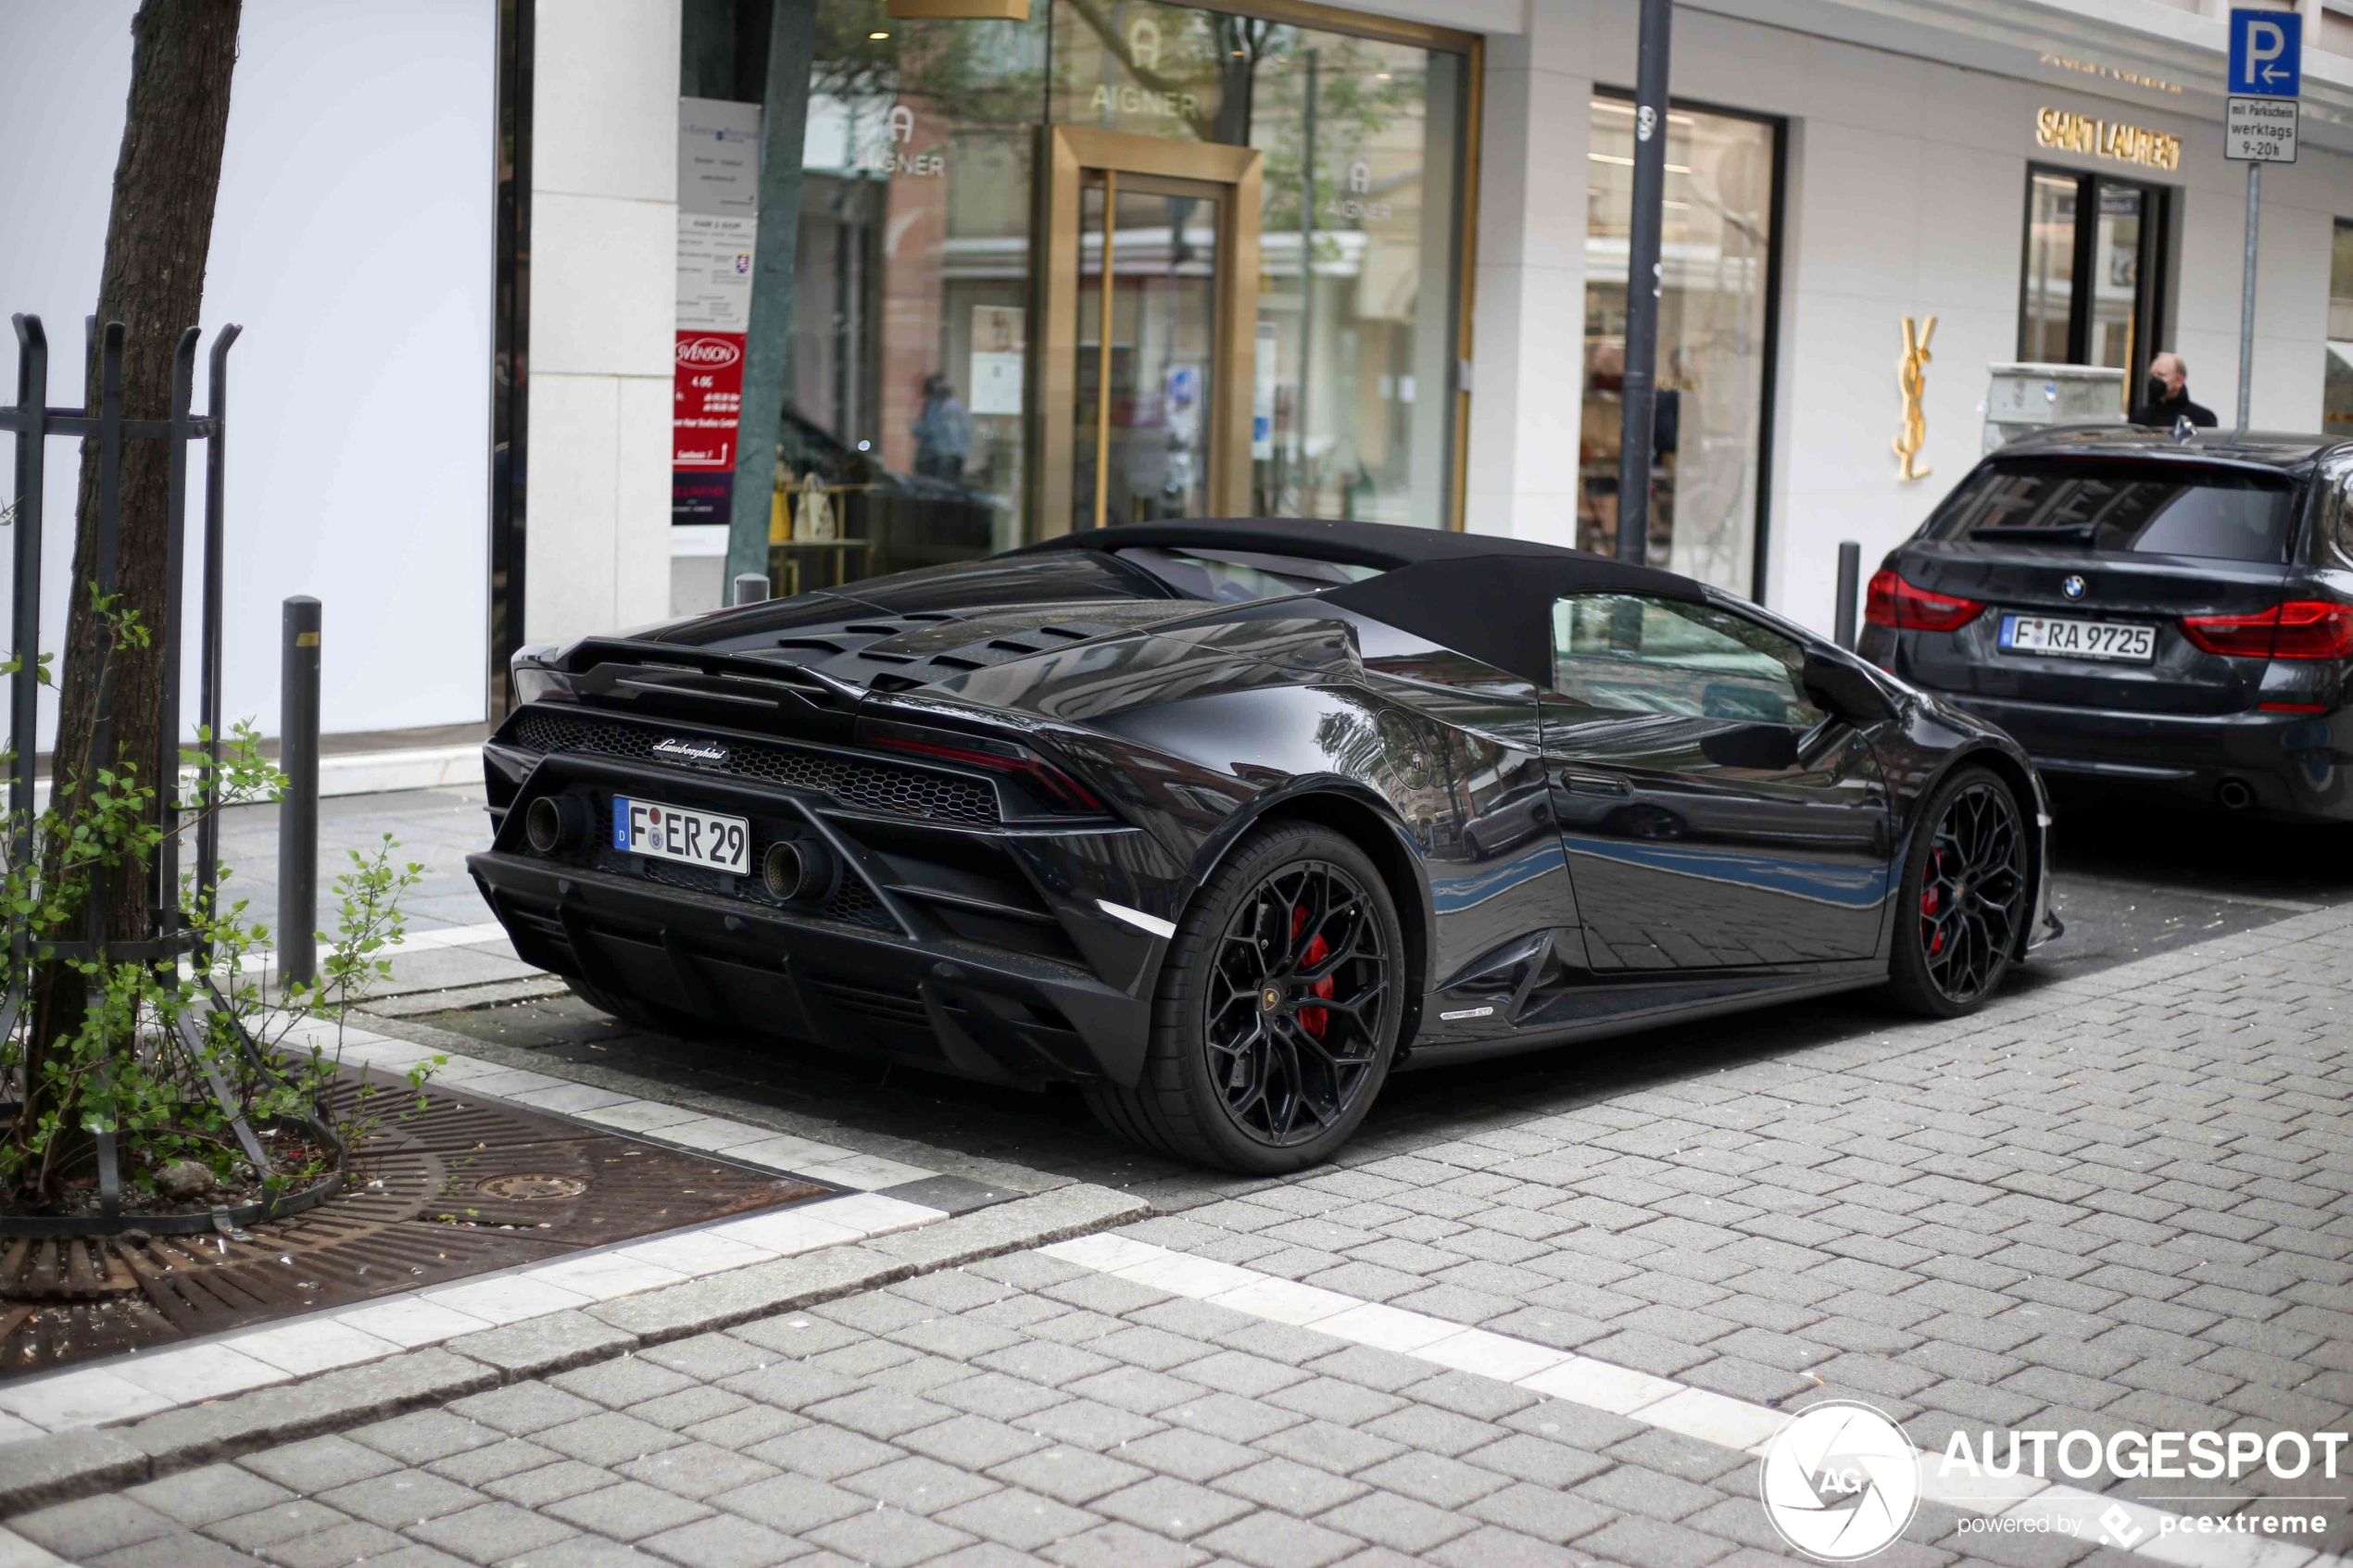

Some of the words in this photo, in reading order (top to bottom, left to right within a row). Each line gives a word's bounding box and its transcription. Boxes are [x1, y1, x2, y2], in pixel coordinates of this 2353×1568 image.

[2245, 19, 2285, 84] P
[1090, 84, 1199, 120] AIGNER
[2232, 105, 2246, 117] mit
[2249, 105, 2294, 119] Parkschein
[2231, 123, 2293, 140] werktags
[677, 345, 732, 362] SVENSON
[2015, 621, 2032, 644] F
[2047, 622, 2079, 648] RA
[2087, 626, 2151, 655] 9725
[653, 739, 725, 759] Lamborghini
[619, 830, 625, 842] D
[630, 807, 648, 847] F
[665, 812, 703, 859] ER
[710, 821, 745, 866] 29
